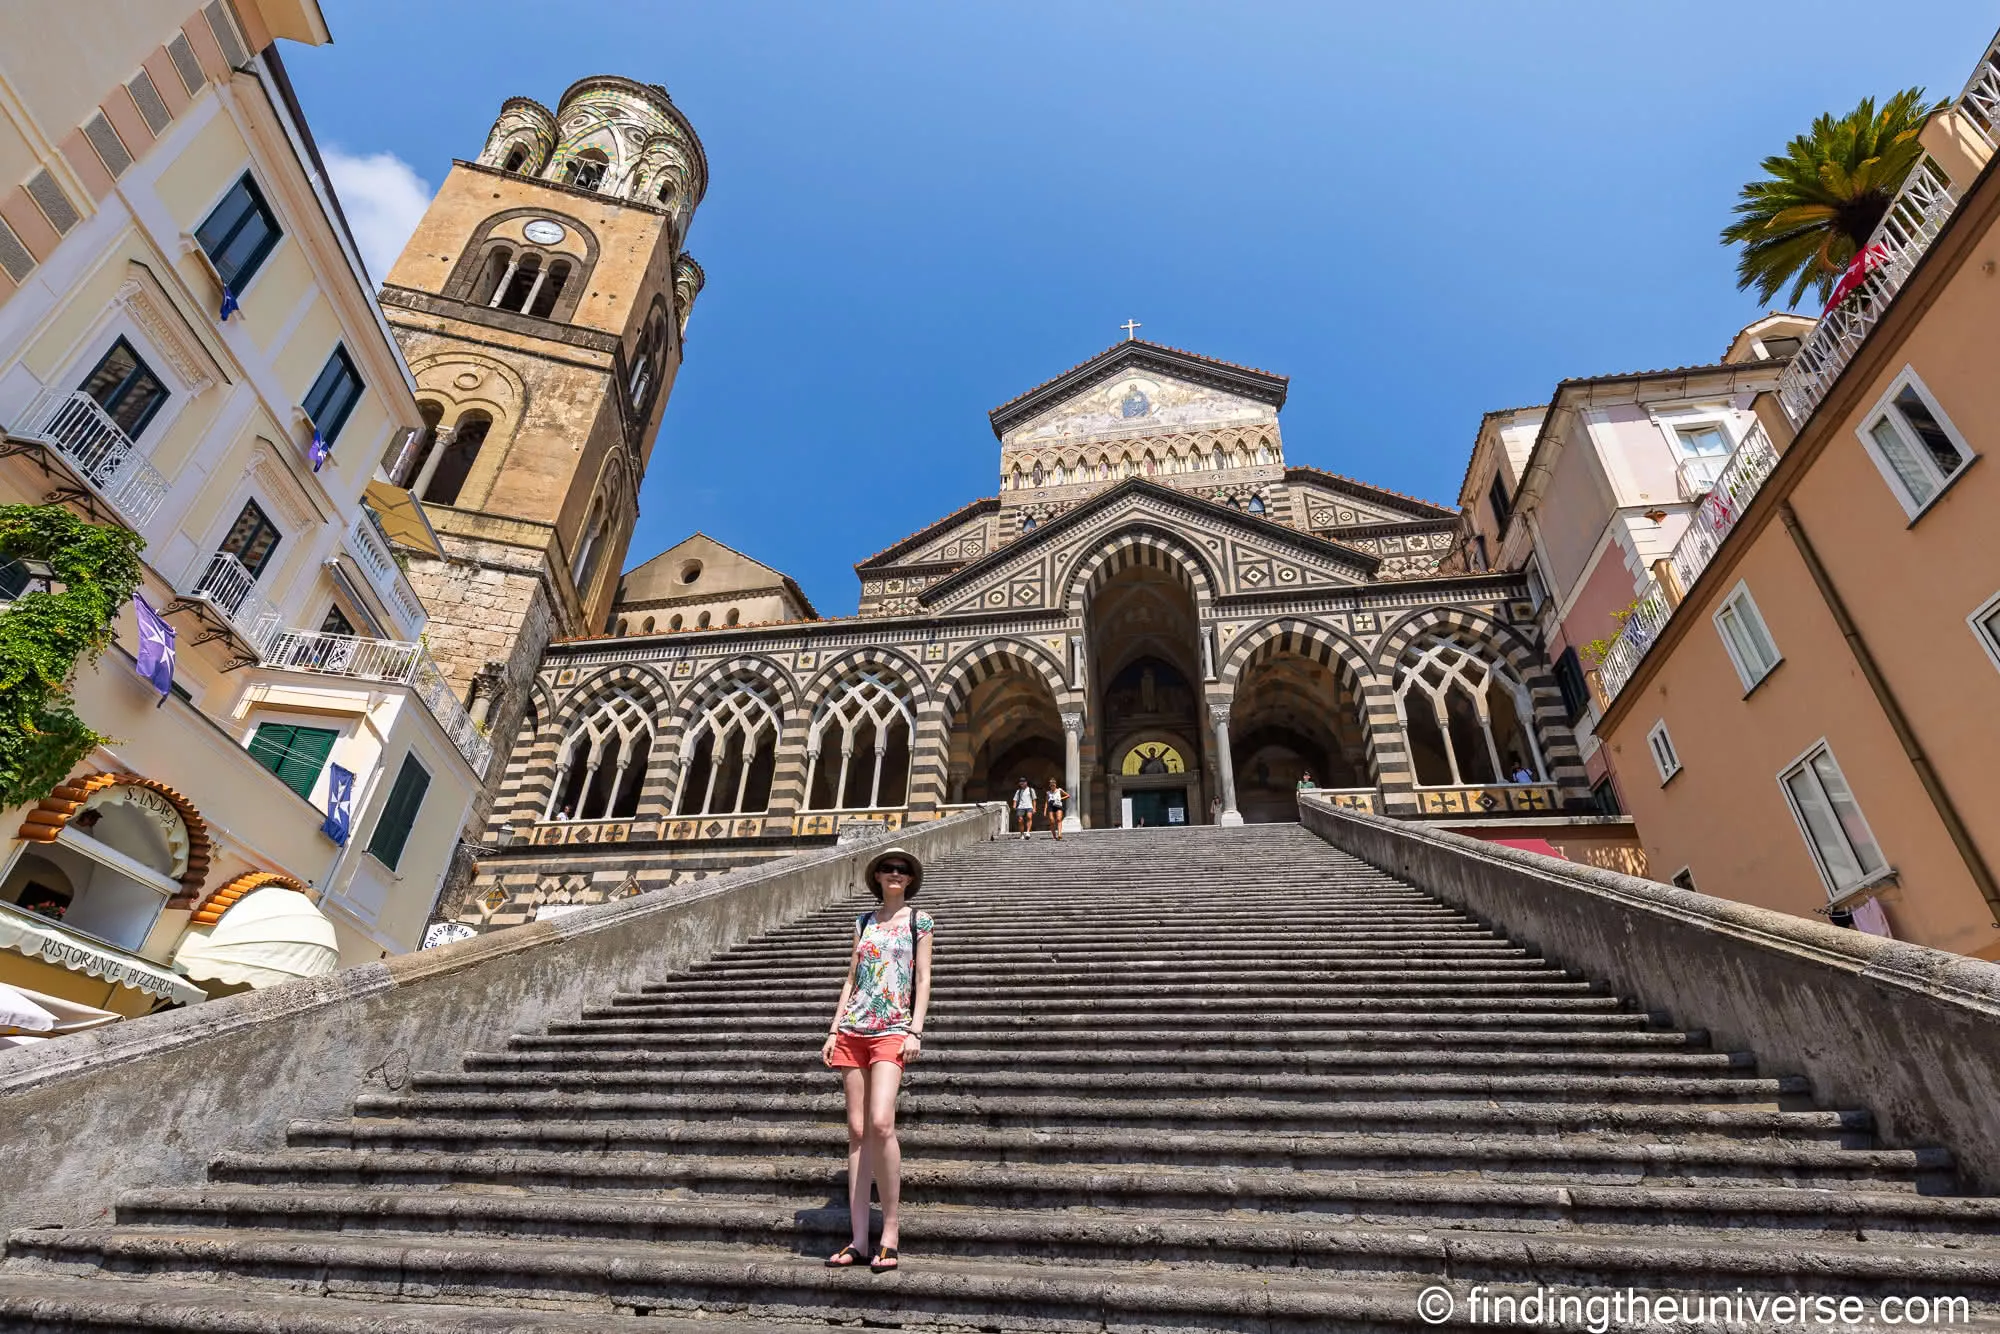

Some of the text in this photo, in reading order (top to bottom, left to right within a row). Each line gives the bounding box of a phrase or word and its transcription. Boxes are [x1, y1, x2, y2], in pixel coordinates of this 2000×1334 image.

[139, 791, 178, 828] NDRA
[429, 924, 469, 942] RISTORAN
[40, 937, 175, 995] RISTORANTE PIZZERIA
